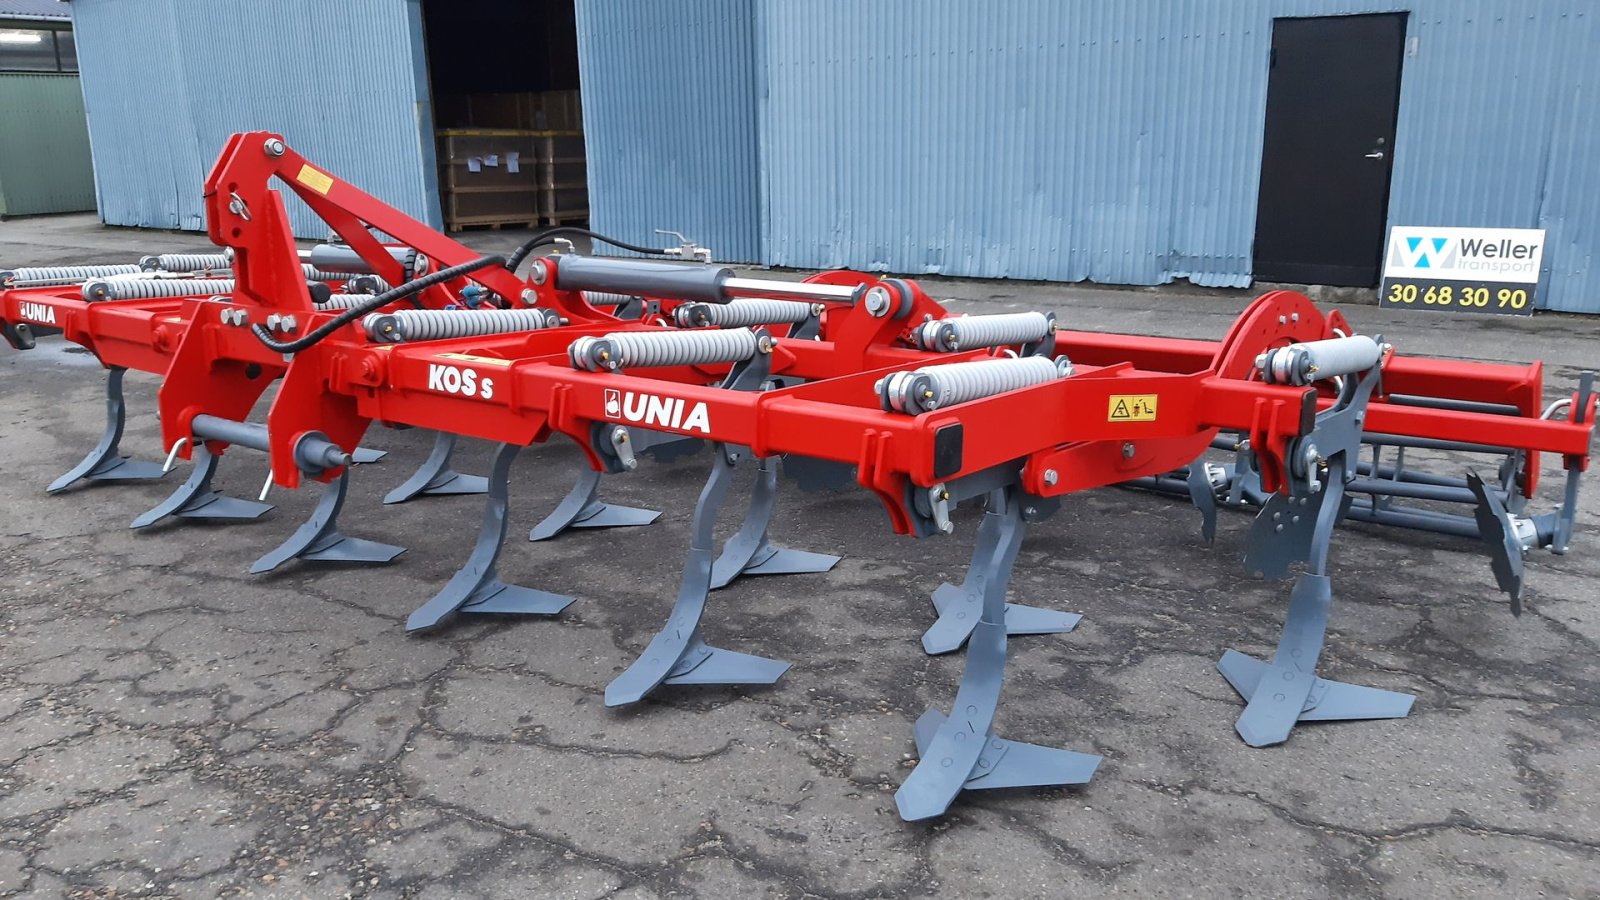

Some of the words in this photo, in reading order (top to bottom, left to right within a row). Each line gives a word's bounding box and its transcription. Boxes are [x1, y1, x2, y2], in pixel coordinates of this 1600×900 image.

[1460, 238, 1538, 260] Weller
[1458, 260, 1535, 273] transport
[1388, 284, 1418, 304] 30
[1423, 286, 1453, 305] 68
[1459, 287, 1490, 307] 30
[1497, 289, 1527, 309] 90
[26, 302, 56, 324] UNIA
[428, 363, 477, 397] KOS
[623, 391, 711, 434] UNIA
